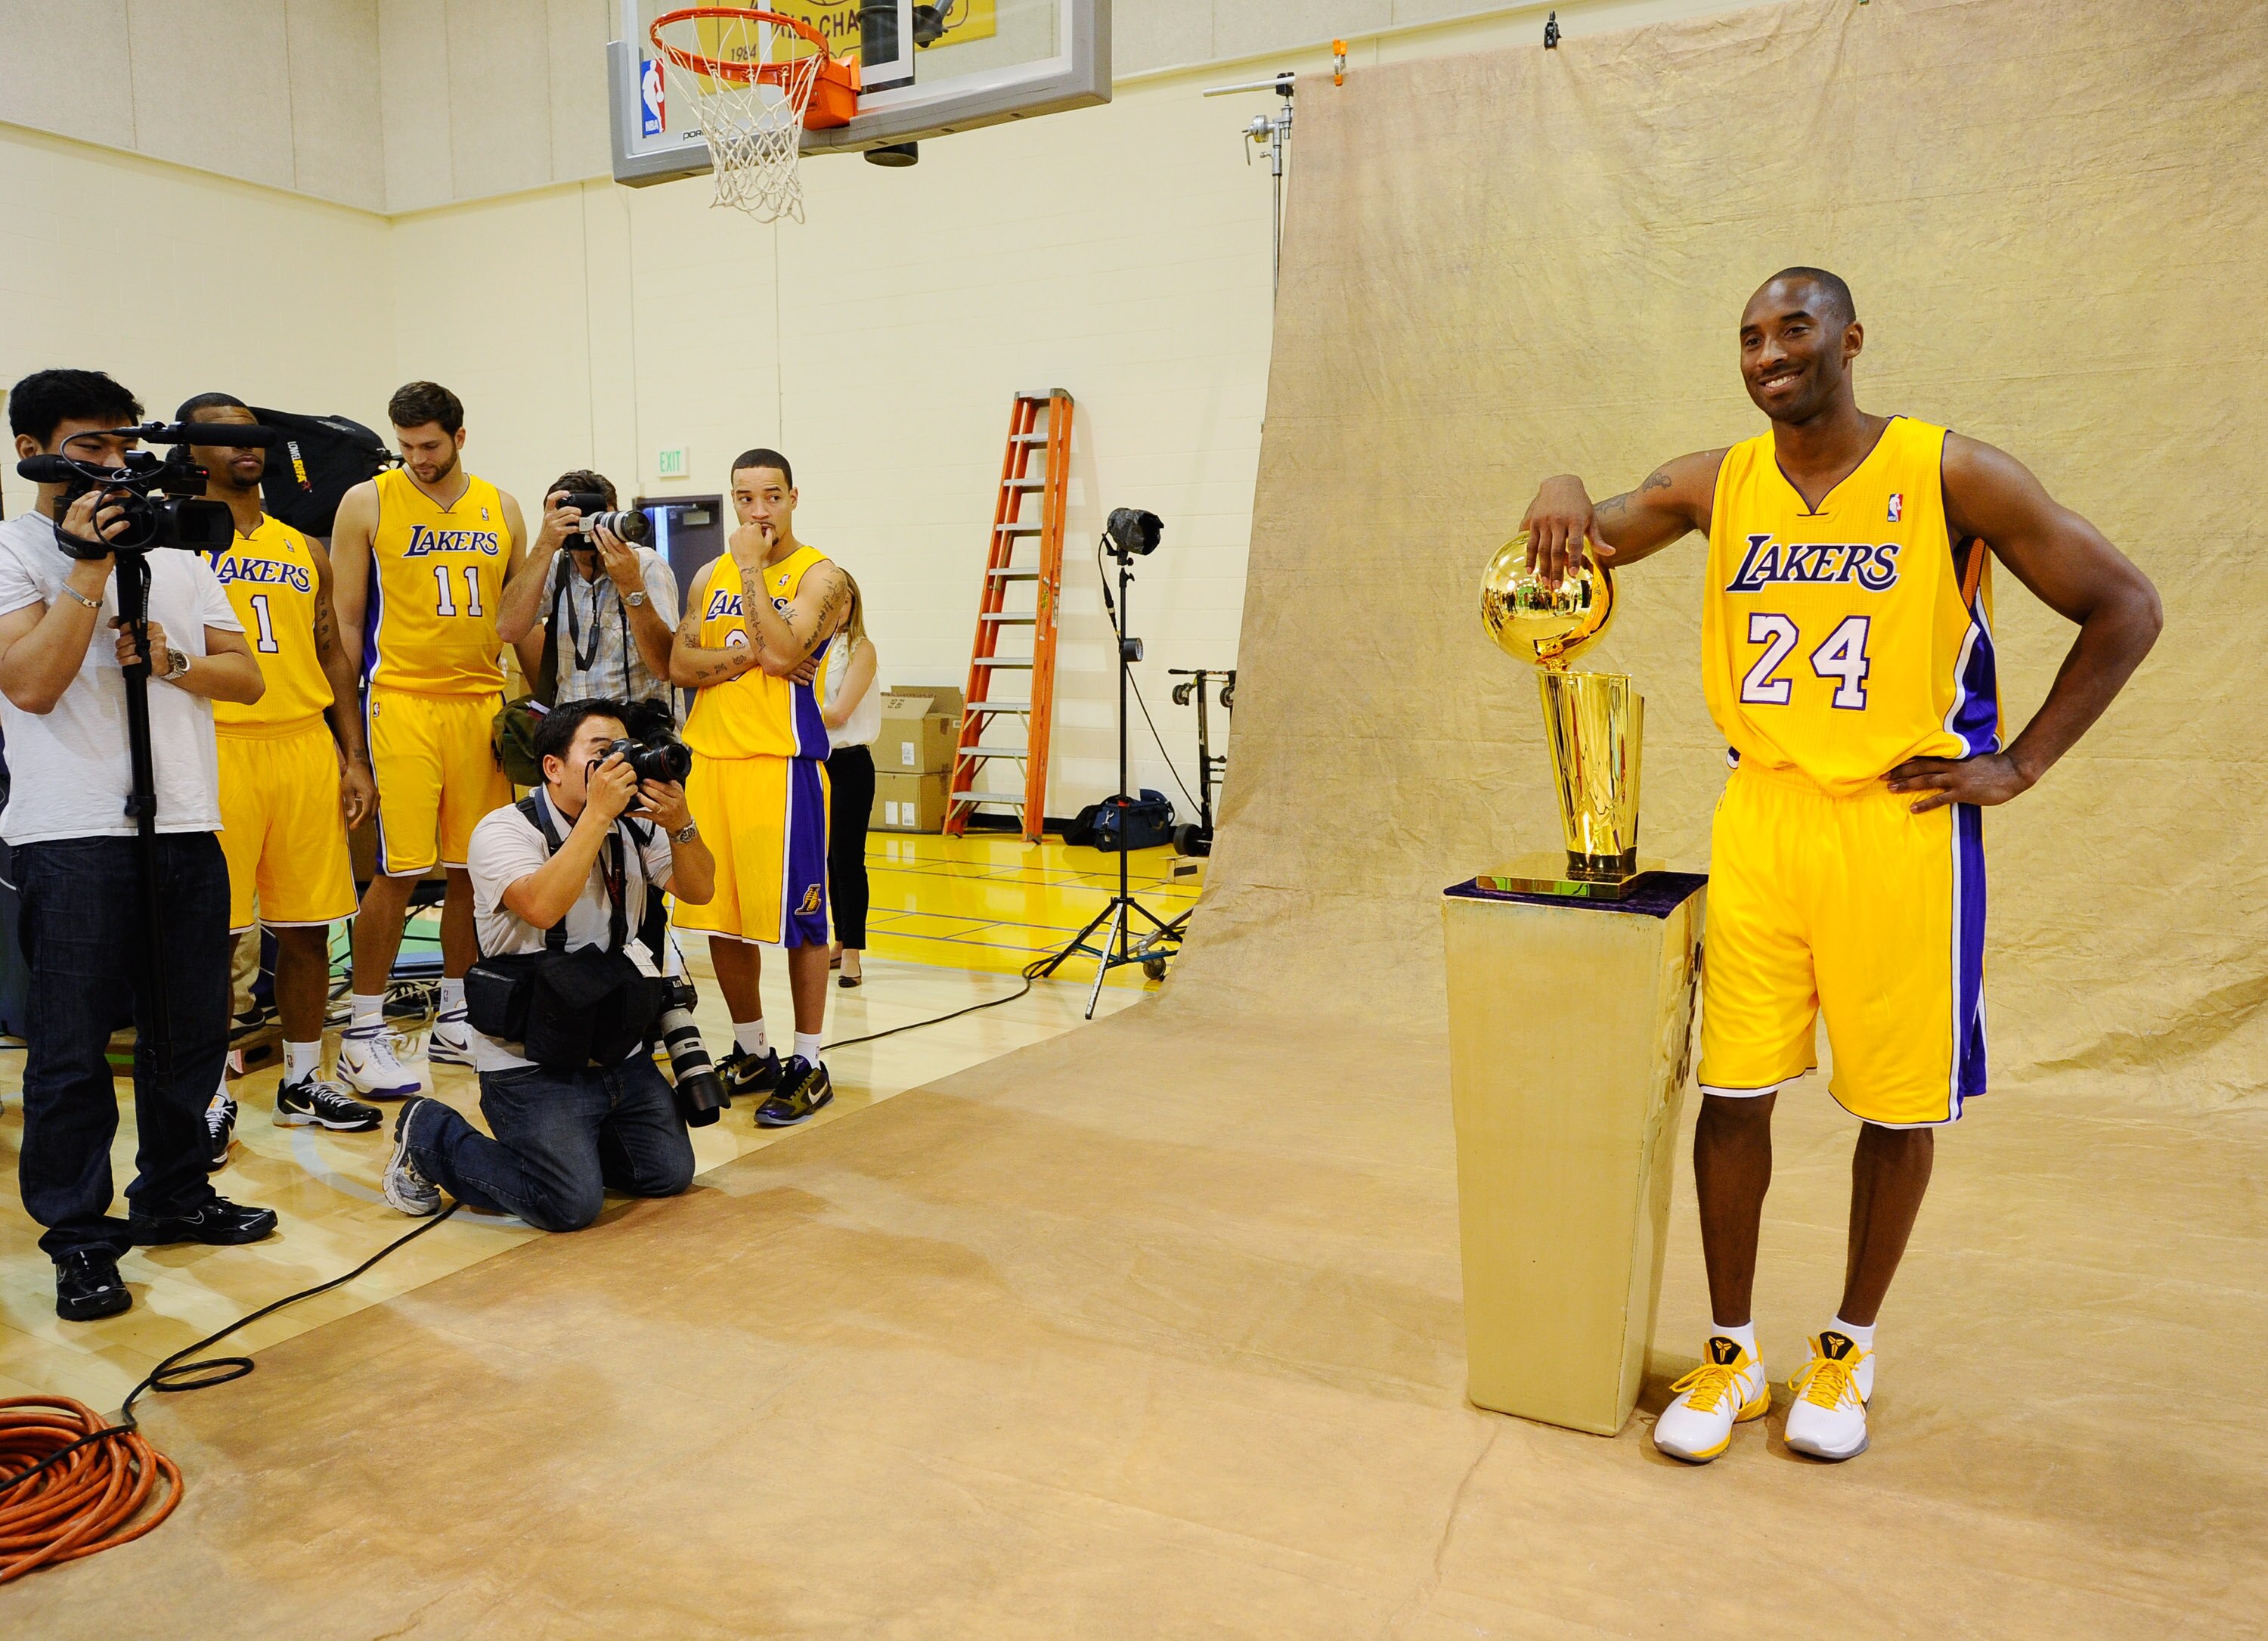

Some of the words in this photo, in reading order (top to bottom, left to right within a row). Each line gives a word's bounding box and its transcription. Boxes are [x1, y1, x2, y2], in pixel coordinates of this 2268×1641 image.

[731, 44, 756, 61] 1984
[645, 119, 658, 132] NBA
[660, 450, 680, 472] EXIT
[402, 525, 499, 557] LAKERS
[206, 551, 311, 594] LAKERS
[1725, 534, 1902, 593] LAKERS
[433, 565, 483, 617] 11
[704, 588, 789, 622] LAKS
[250, 594, 279, 653] 1
[1740, 613, 1871, 711] 24
